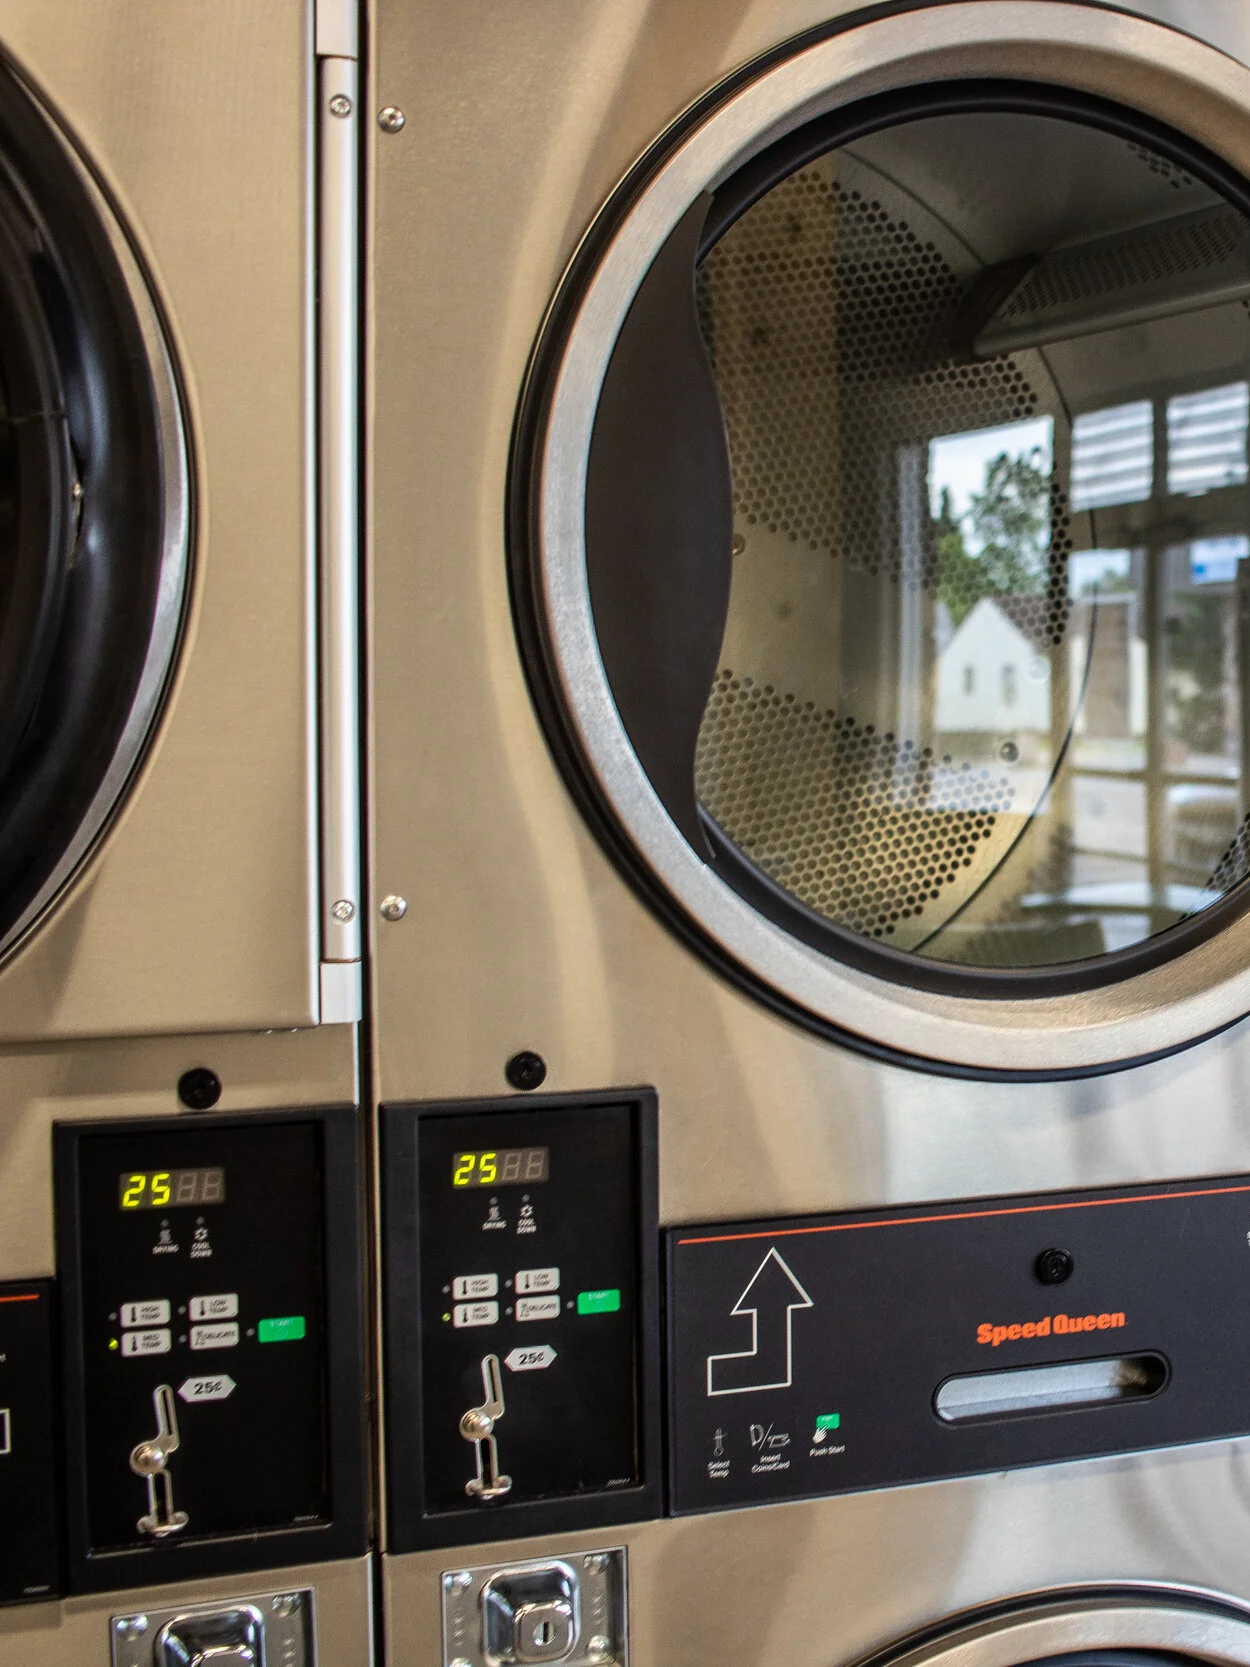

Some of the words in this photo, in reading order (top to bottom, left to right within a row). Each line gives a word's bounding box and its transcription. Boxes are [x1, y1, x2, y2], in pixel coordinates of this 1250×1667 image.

[453, 1153, 497, 1186] 25
[122, 1173, 171, 1207] 25
[976, 1315, 1051, 1347] Speed
[1053, 1311, 1126, 1334] Queen
[518, 1351, 545, 1366] 25¢
[194, 1380, 223, 1395] 25¢
